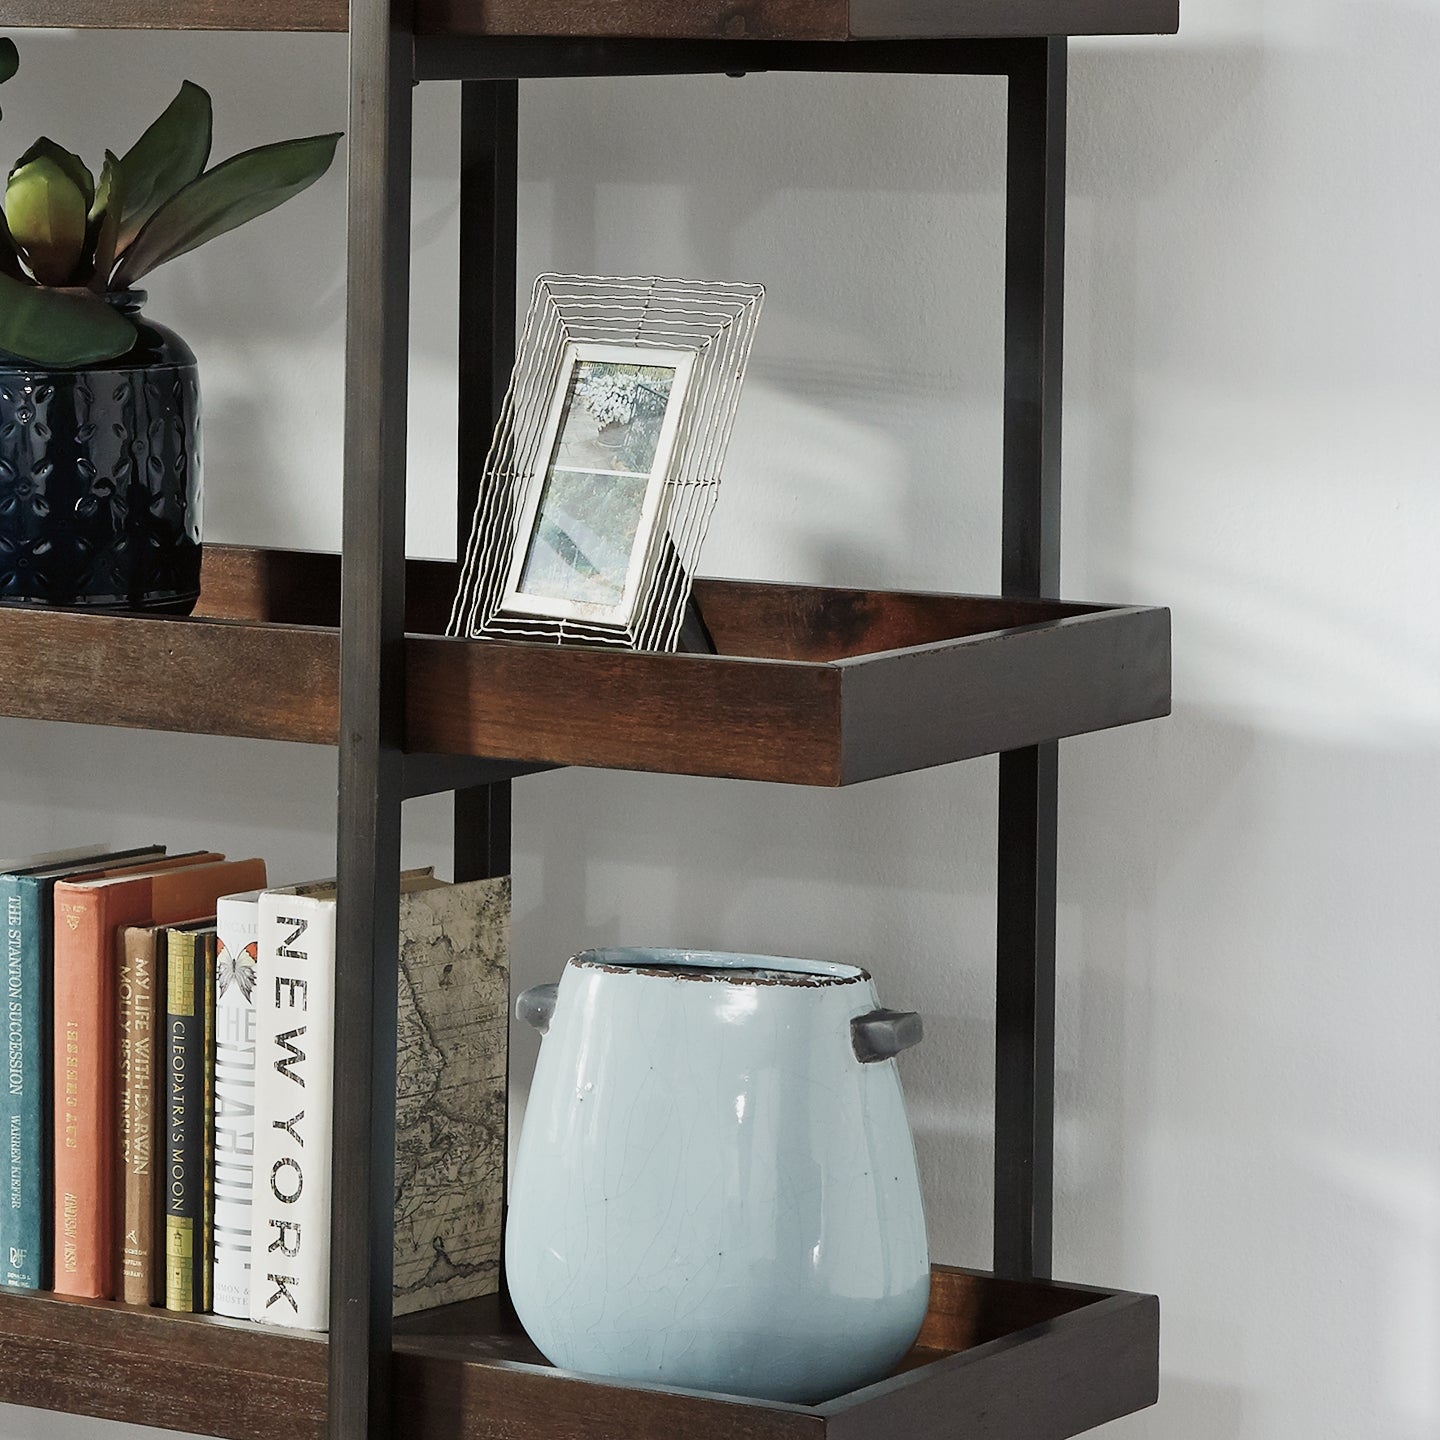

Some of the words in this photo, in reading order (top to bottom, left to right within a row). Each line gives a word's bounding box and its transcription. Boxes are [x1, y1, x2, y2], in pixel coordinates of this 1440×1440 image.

[8, 896, 22, 926] THE
[8, 928, 22, 999] STANTON
[135, 958, 150, 990] MY
[135, 994, 149, 1030] LIFE
[274, 916, 308, 1088] NEW
[9, 1000, 23, 1096] SUCCESSION
[134, 1037, 149, 1090] WITH
[172, 1021, 185, 1142] CLEOPATRA'S
[10, 1114, 21, 1165] WARREN
[133, 1094, 150, 1175] DARWIN
[10, 1166, 21, 1209] KIEFER
[171, 1149, 184, 1210] MOON
[266, 1110, 305, 1313] YORK
